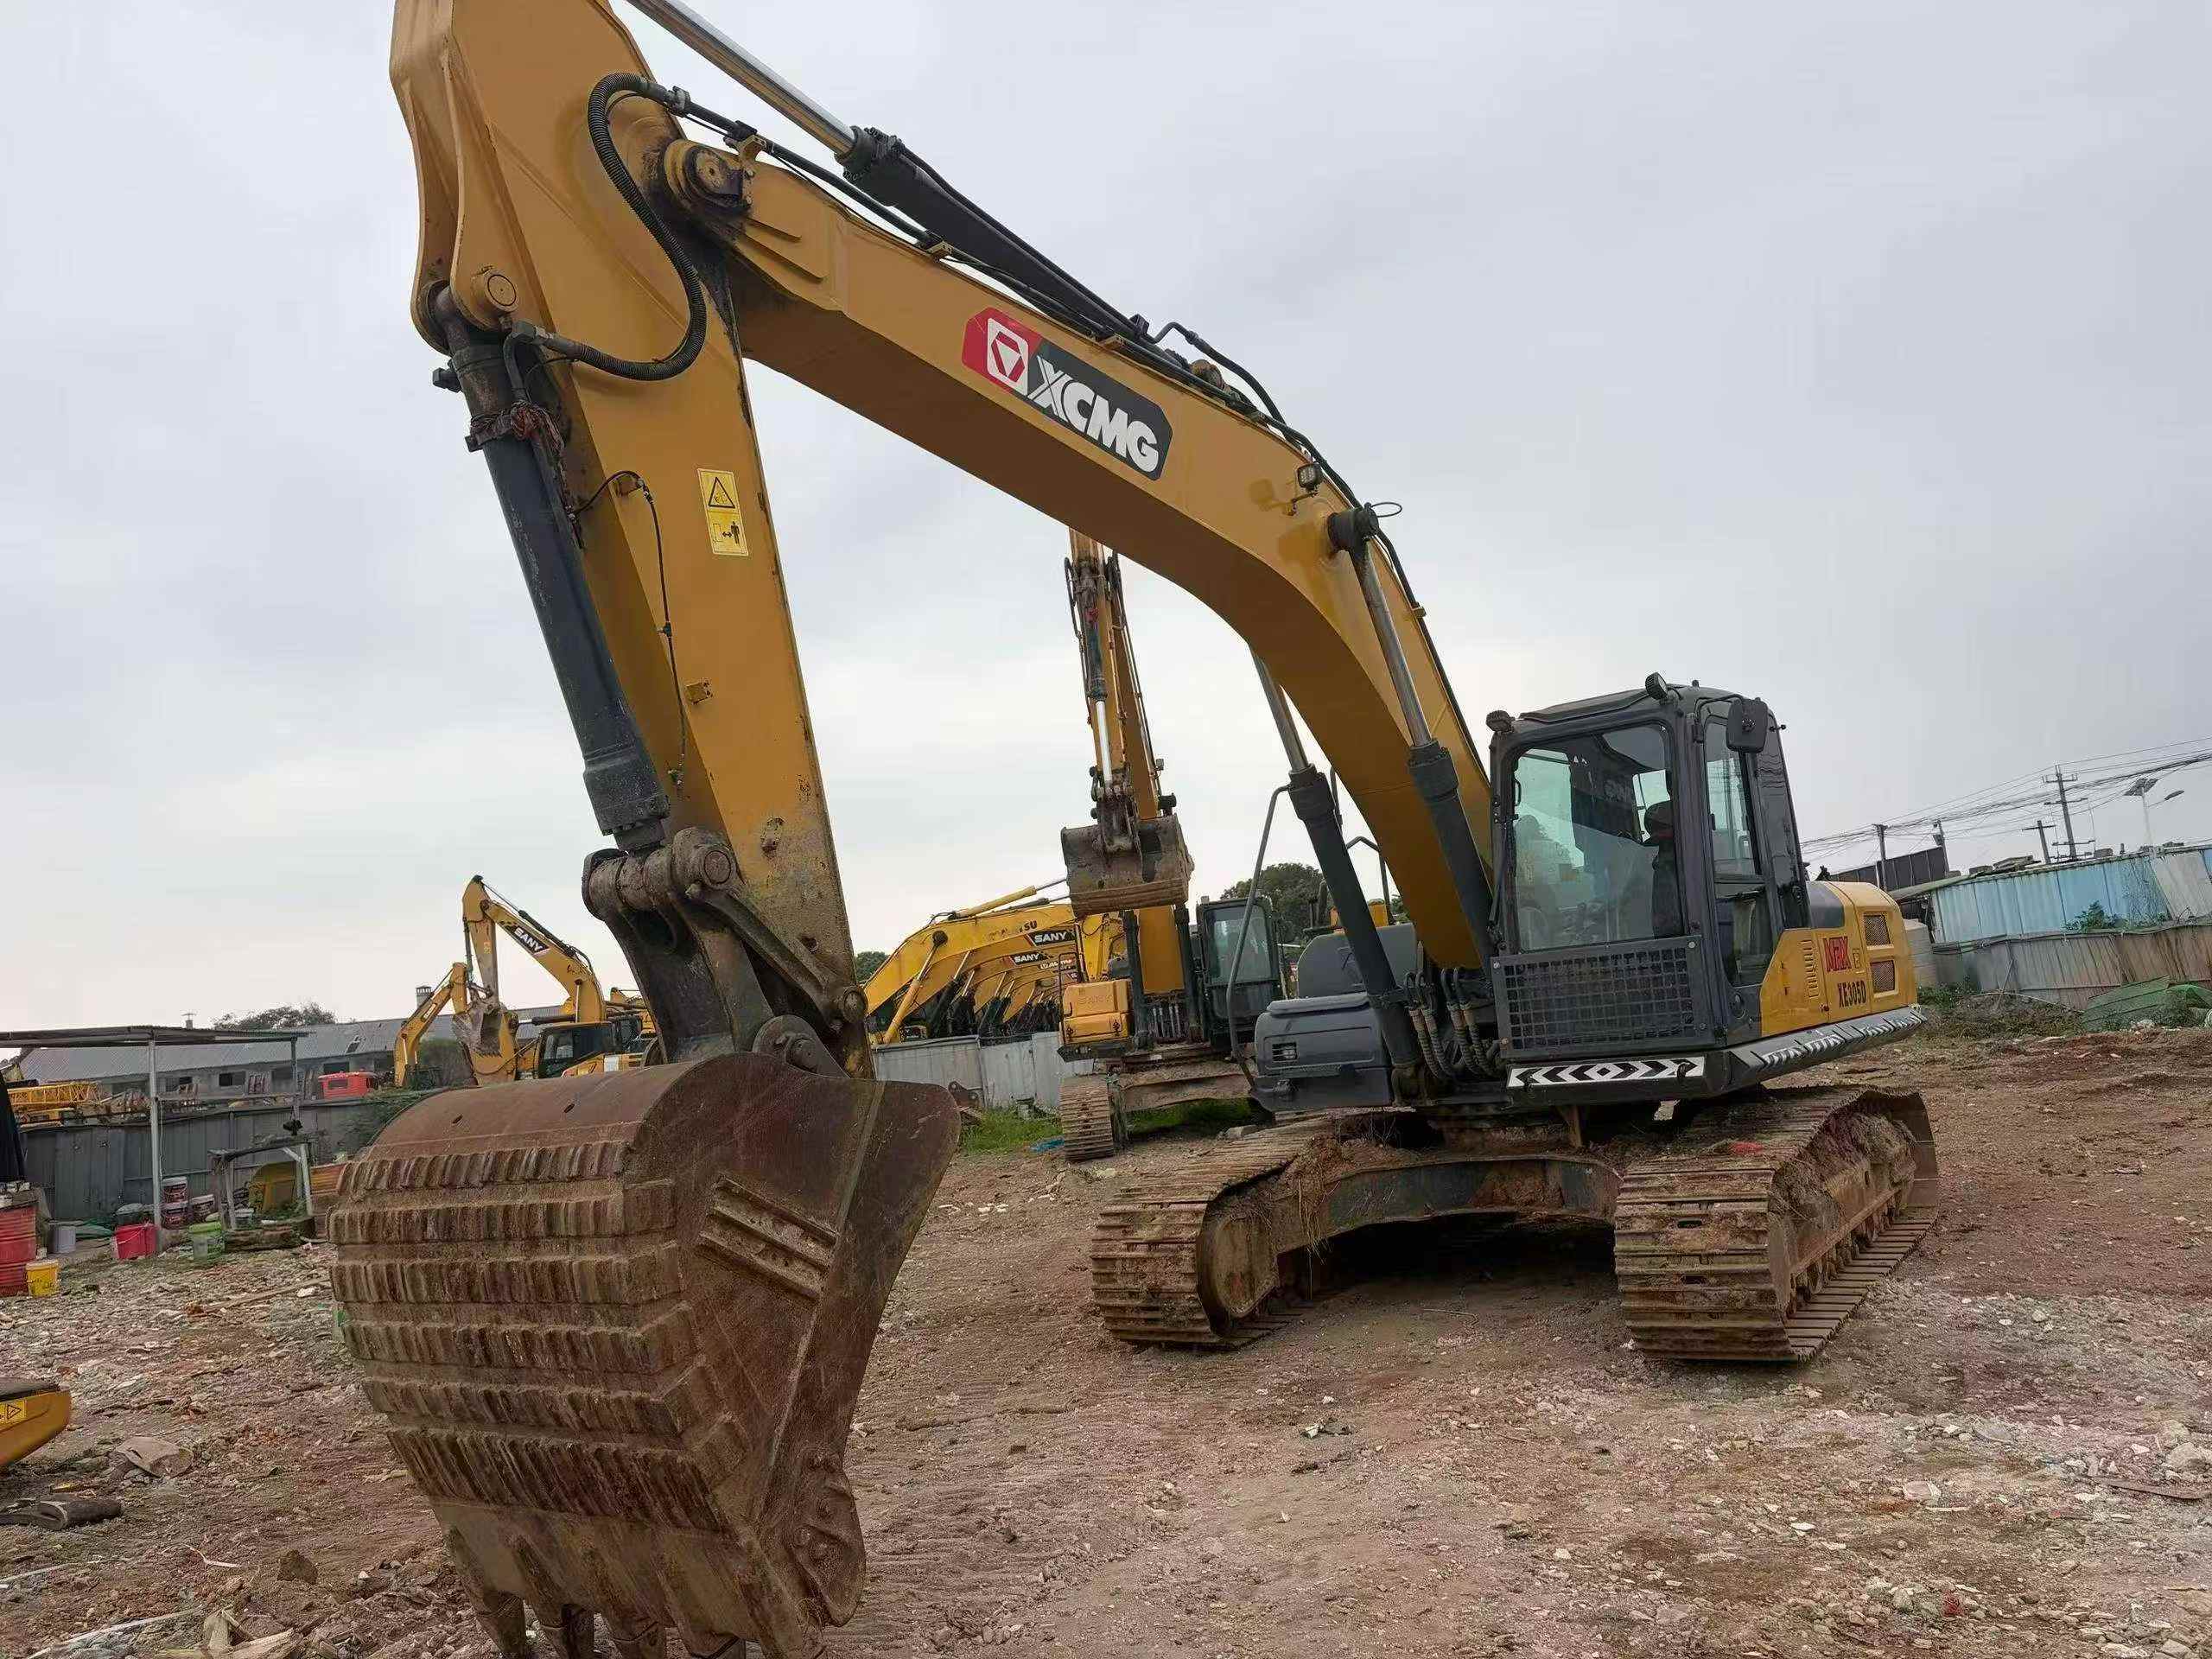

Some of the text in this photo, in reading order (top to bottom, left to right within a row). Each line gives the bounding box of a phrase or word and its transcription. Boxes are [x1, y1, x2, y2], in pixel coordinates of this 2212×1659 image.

[1027, 354, 1159, 473] XCMG
[514, 926, 543, 951] SANY
[1034, 931, 1066, 944] SANY
[1014, 952, 1039, 963] SANY
